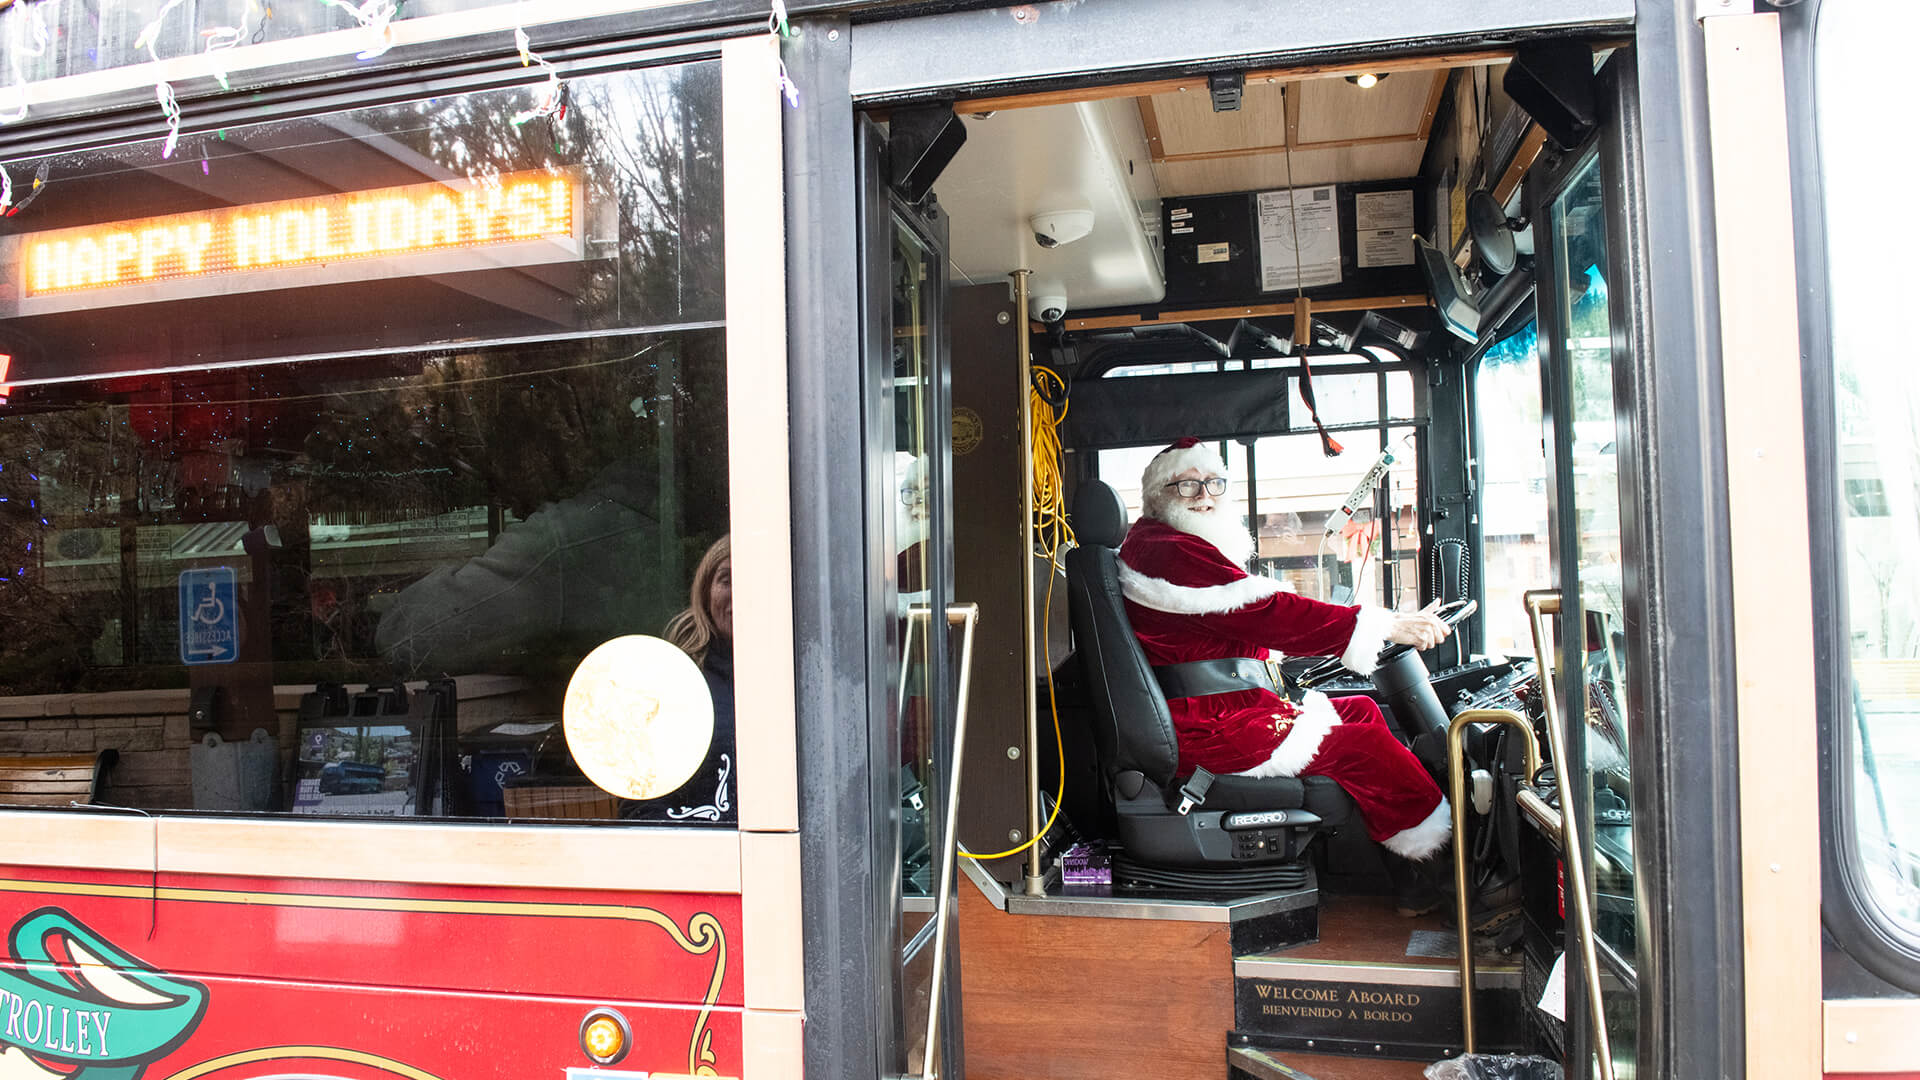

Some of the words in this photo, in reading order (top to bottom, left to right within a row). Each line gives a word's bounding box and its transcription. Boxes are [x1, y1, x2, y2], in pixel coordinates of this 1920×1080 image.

[36, 222, 212, 290] HAPPY
[235, 180, 567, 266] HOLIDAYS!
[1235, 811, 1282, 825] RECARO
[1263, 1005, 1343, 1018] BIENVENIDO
[1348, 1009, 1358, 1019] A
[1364, 1010, 1413, 1022] BORDO
